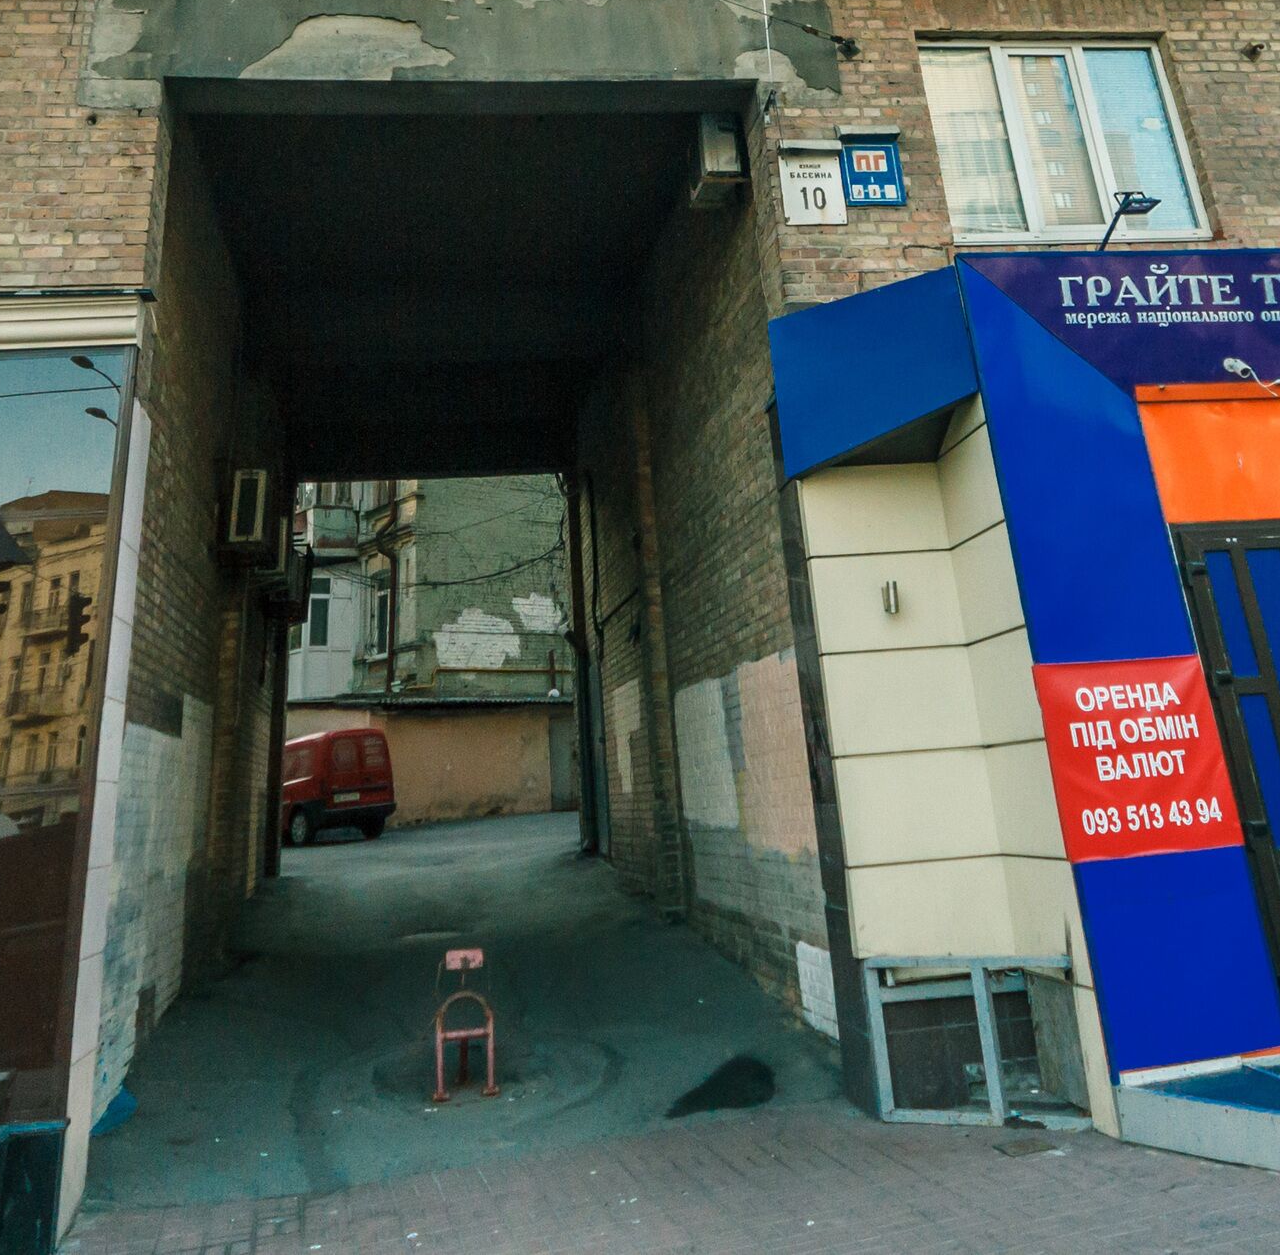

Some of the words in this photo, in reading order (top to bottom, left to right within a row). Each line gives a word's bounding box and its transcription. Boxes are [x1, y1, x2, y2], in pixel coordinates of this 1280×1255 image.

[855, 154, 886, 171] ПГ
[800, 186, 827, 210] 10
[1058, 264, 1241, 307] ГРАЙТЕ
[1065, 310, 1131, 328] мережа
[1137, 306, 1254, 327] національного
[1075, 682, 1181, 712] ОРЕНДА
[1069, 721, 1117, 750] ПІД
[1120, 713, 1199, 743] ОБМІН
[1096, 749, 1186, 782] ВАЛЮТ
[1082, 807, 1122, 835] 093
[1127, 803, 1164, 830] 513
[1169, 799, 1194, 826] 43
[1195, 796, 1222, 823] 94
